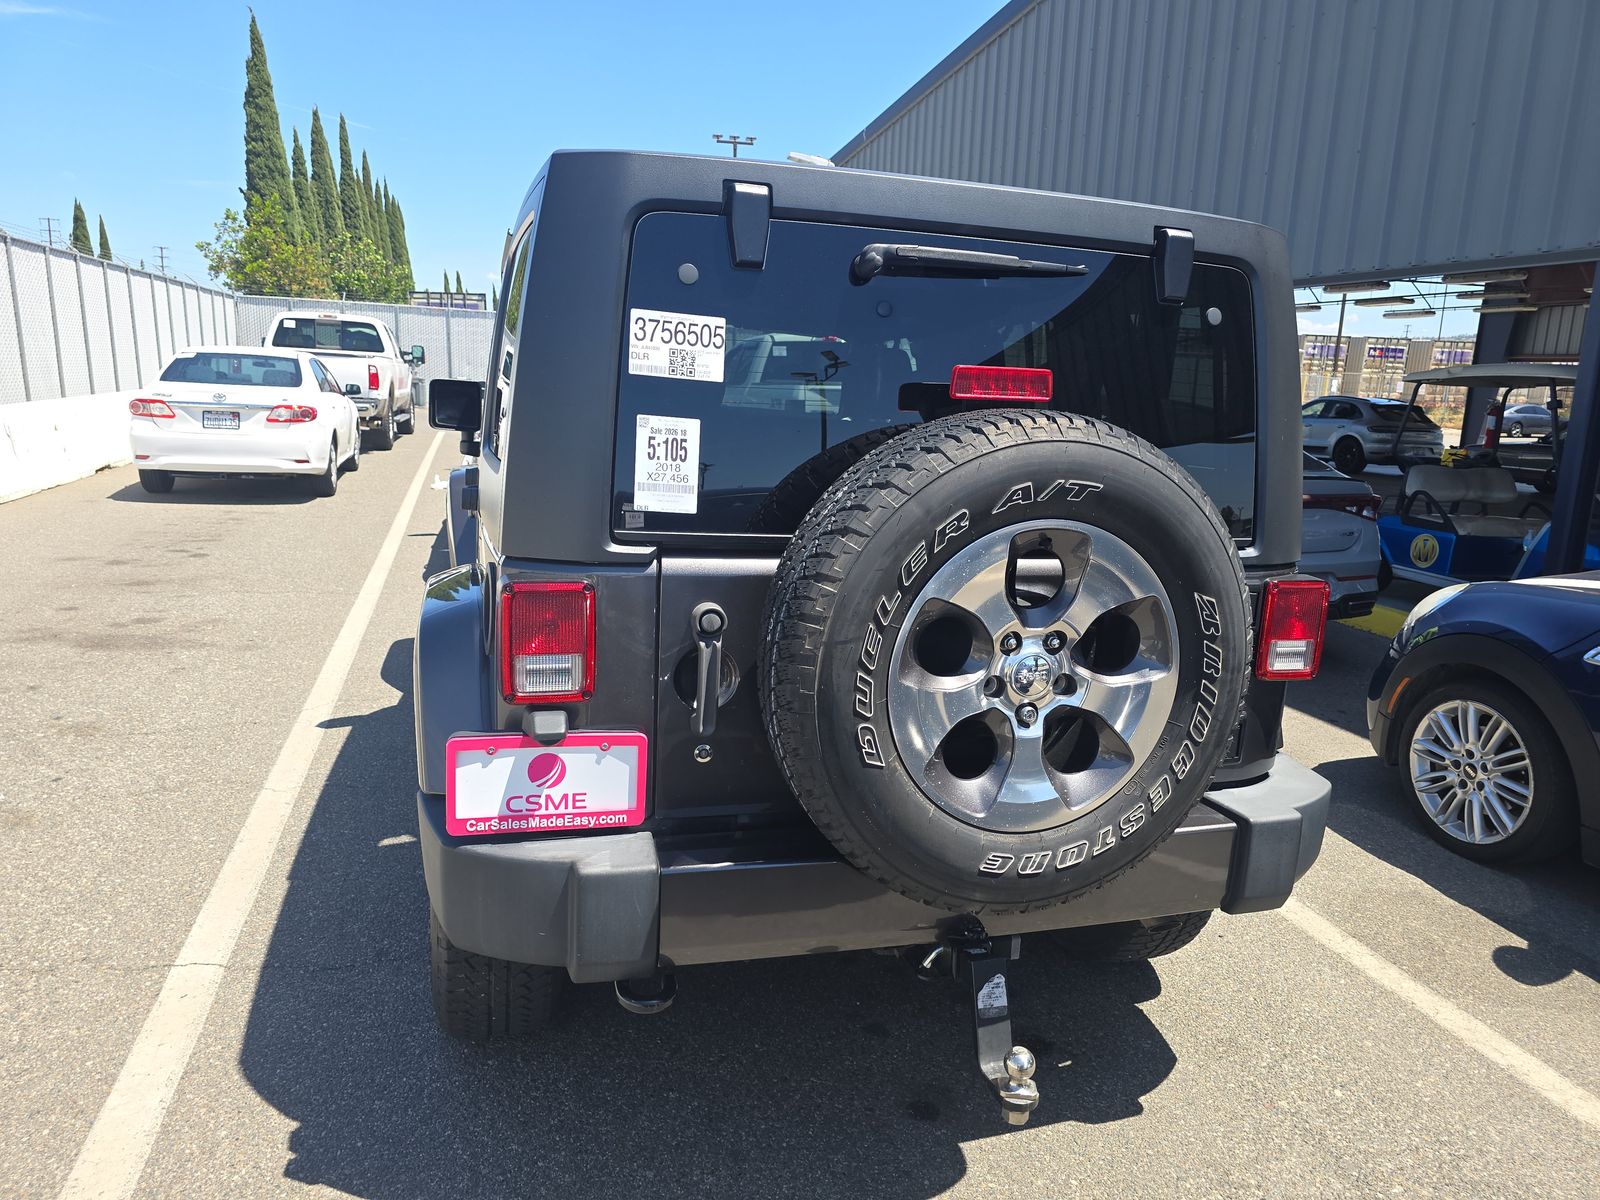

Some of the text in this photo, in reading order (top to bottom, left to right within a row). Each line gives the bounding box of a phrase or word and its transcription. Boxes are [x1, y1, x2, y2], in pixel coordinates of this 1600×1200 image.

[633, 316, 725, 349] 3756505
[631, 351, 650, 361] DLR
[650, 426, 663, 435] Sale
[665, 427, 679, 436] 2026
[647, 435, 688, 463] 5:105
[646, 471, 689, 484] X27,456
[655, 462, 681, 473] 2018
[991, 479, 1104, 515] A/T
[978, 591, 1224, 876] BRIDGESTONE
[505, 792, 587, 813] CSME
[466, 813, 627, 832] CarSalesMadeEasy.com
